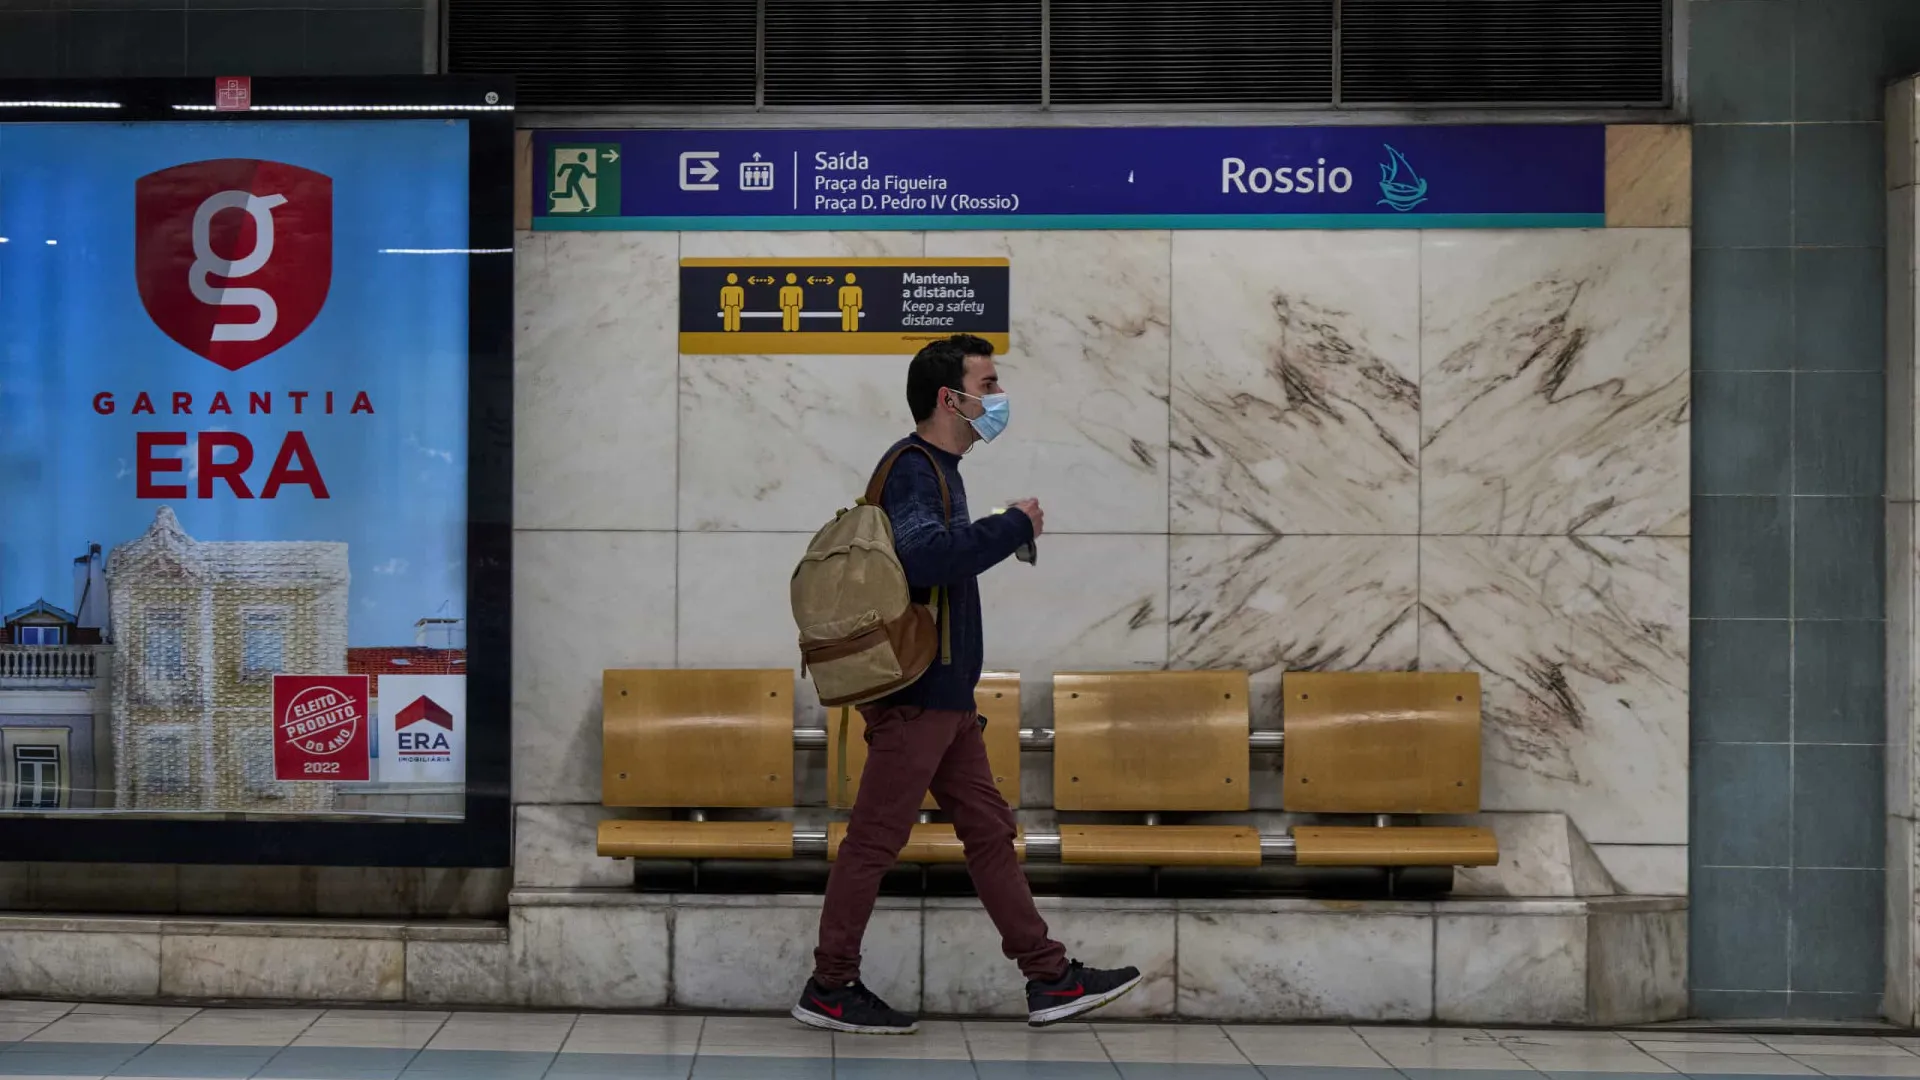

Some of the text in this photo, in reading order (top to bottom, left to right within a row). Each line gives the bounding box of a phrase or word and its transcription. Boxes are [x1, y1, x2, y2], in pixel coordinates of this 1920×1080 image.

[815, 150, 869, 170] Saída
[815, 174, 947, 194] Praça da Figueira
[1221, 157, 1353, 194] Rossio
[815, 193, 1020, 213] Praça D. Pedro IV (Rossio)
[902, 272, 970, 284] Mantenha
[902, 286, 975, 298] a distância
[902, 300, 984, 315] Keep a safety
[902, 313, 954, 325] distance
[92, 391, 375, 415] GARANTIA
[136, 430, 331, 499] ERA
[294, 693, 336, 717] ELEITO
[286, 706, 355, 739] PRODUTO
[305, 728, 350, 752] DO ANO
[398, 732, 450, 750] ERA
[303, 762, 340, 774] 2022
